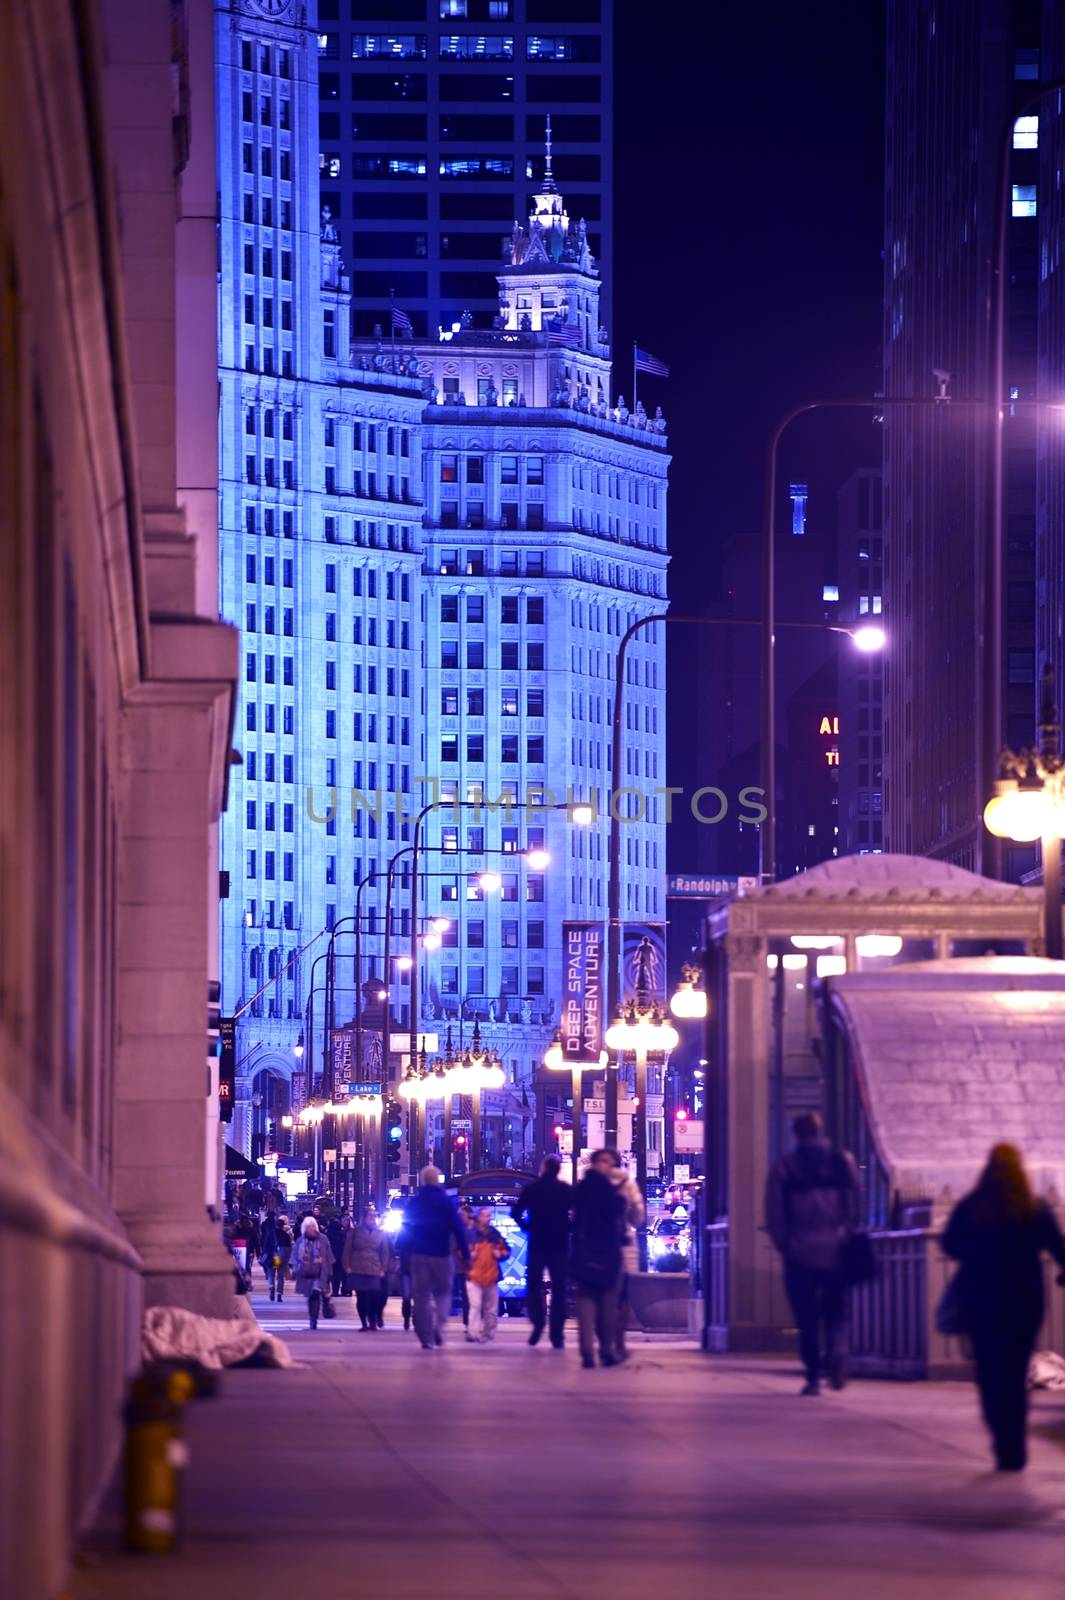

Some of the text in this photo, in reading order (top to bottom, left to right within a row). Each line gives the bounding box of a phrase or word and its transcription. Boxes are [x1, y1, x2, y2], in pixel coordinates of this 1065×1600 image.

[676, 878, 729, 895] Randolph
[567, 931, 582, 1051] DEEP SPACE
[584, 931, 599, 1053] ADVENTURE
[334, 1035, 343, 1100] DEEP SPACE
[355, 1084, 373, 1092] Lake
